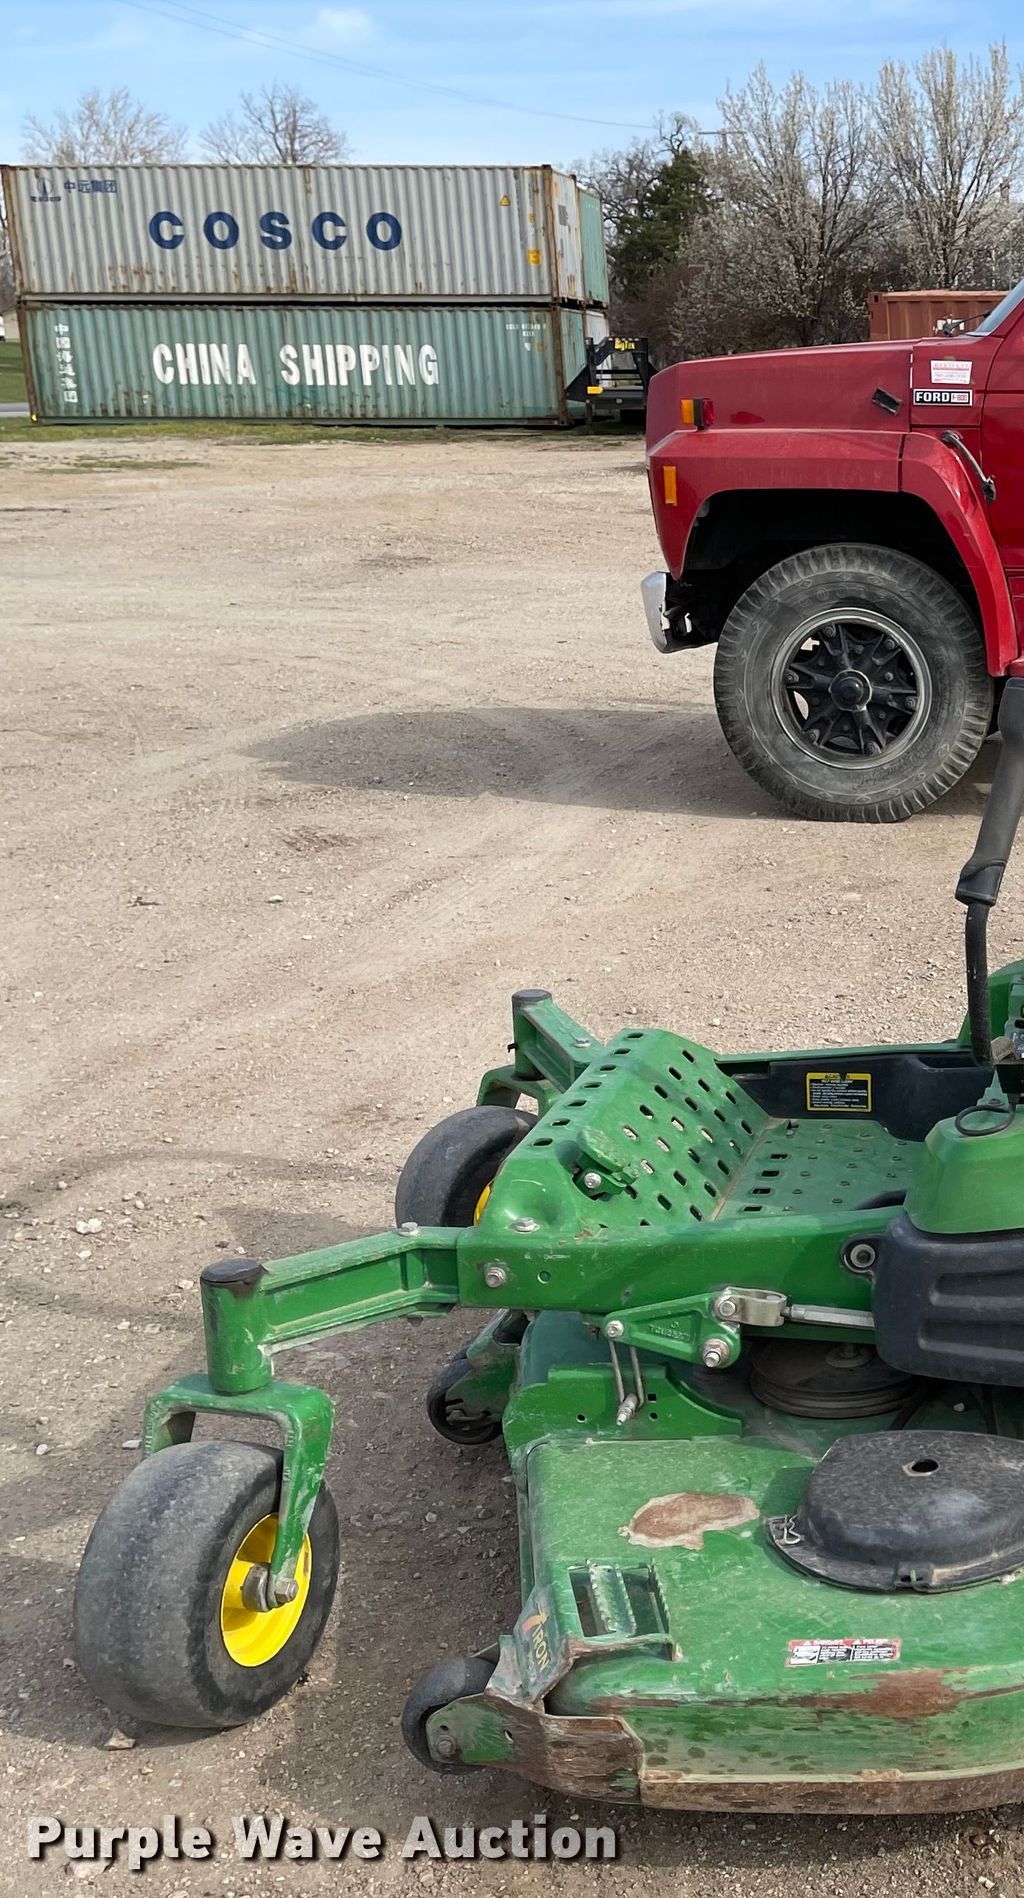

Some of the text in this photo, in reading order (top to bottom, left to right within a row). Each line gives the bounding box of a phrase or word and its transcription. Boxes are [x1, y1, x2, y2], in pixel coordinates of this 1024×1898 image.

[149, 211, 402, 251] COSCO
[152, 343, 440, 386] CHINA SHIPPING
[916, 392, 950, 402] FORD
